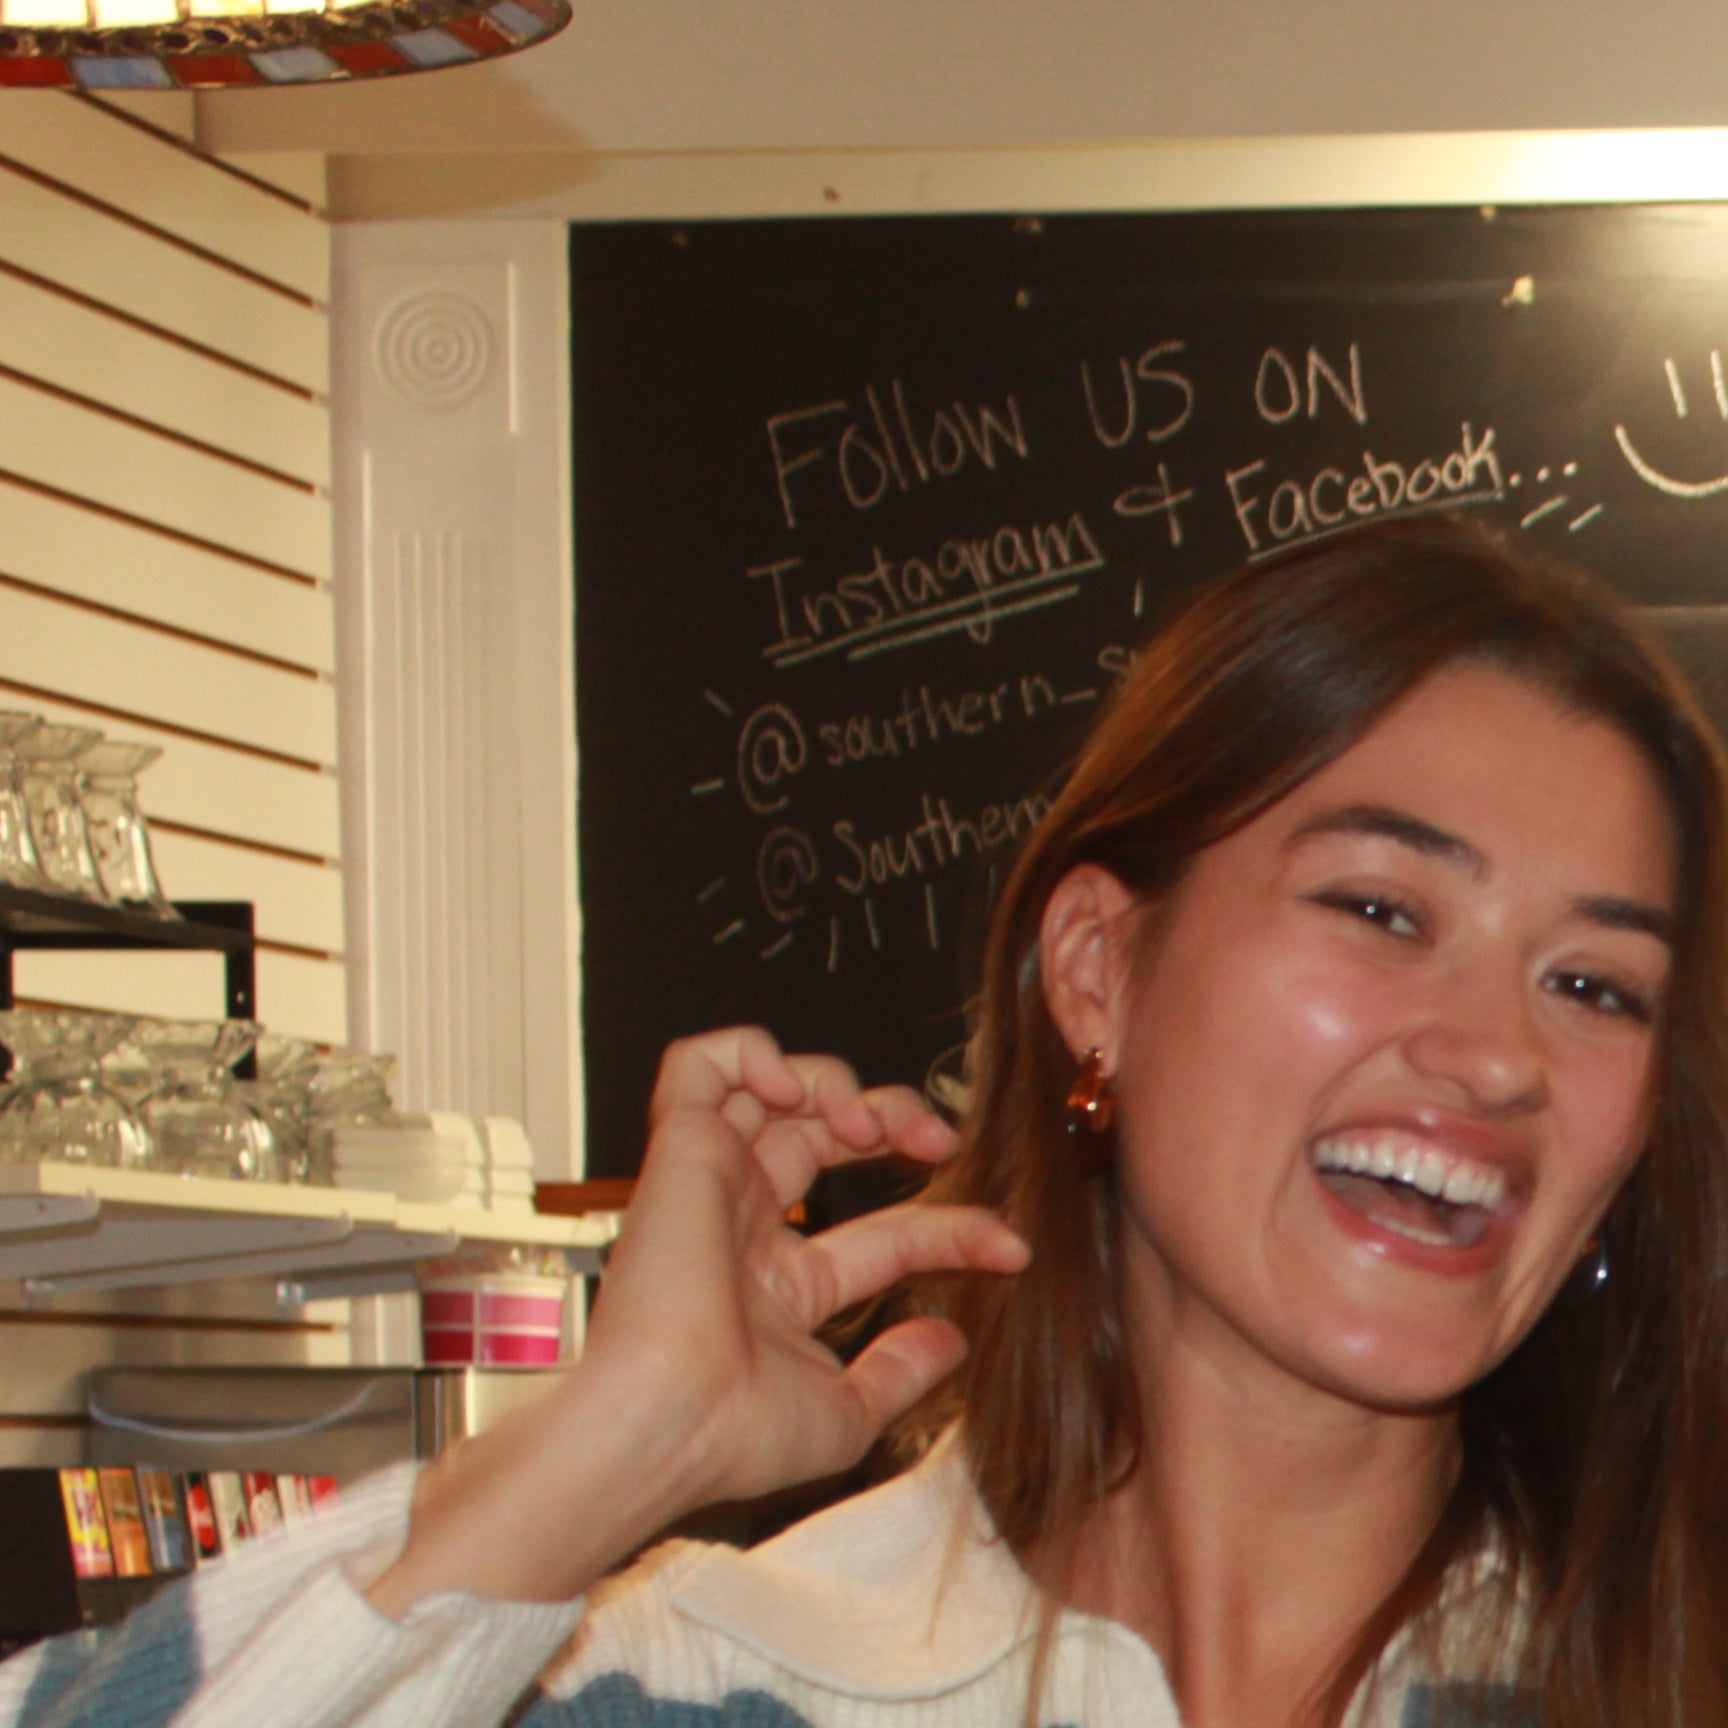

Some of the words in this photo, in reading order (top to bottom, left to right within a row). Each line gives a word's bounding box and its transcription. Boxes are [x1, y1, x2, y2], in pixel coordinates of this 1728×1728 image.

[767, 378, 1030, 528] Follow
[1081, 342, 1196, 447] US
[1255, 342, 1368, 424] ON
[747, 513, 1103, 658] Instagram
[737, 645, 1140, 815] @southern_s
